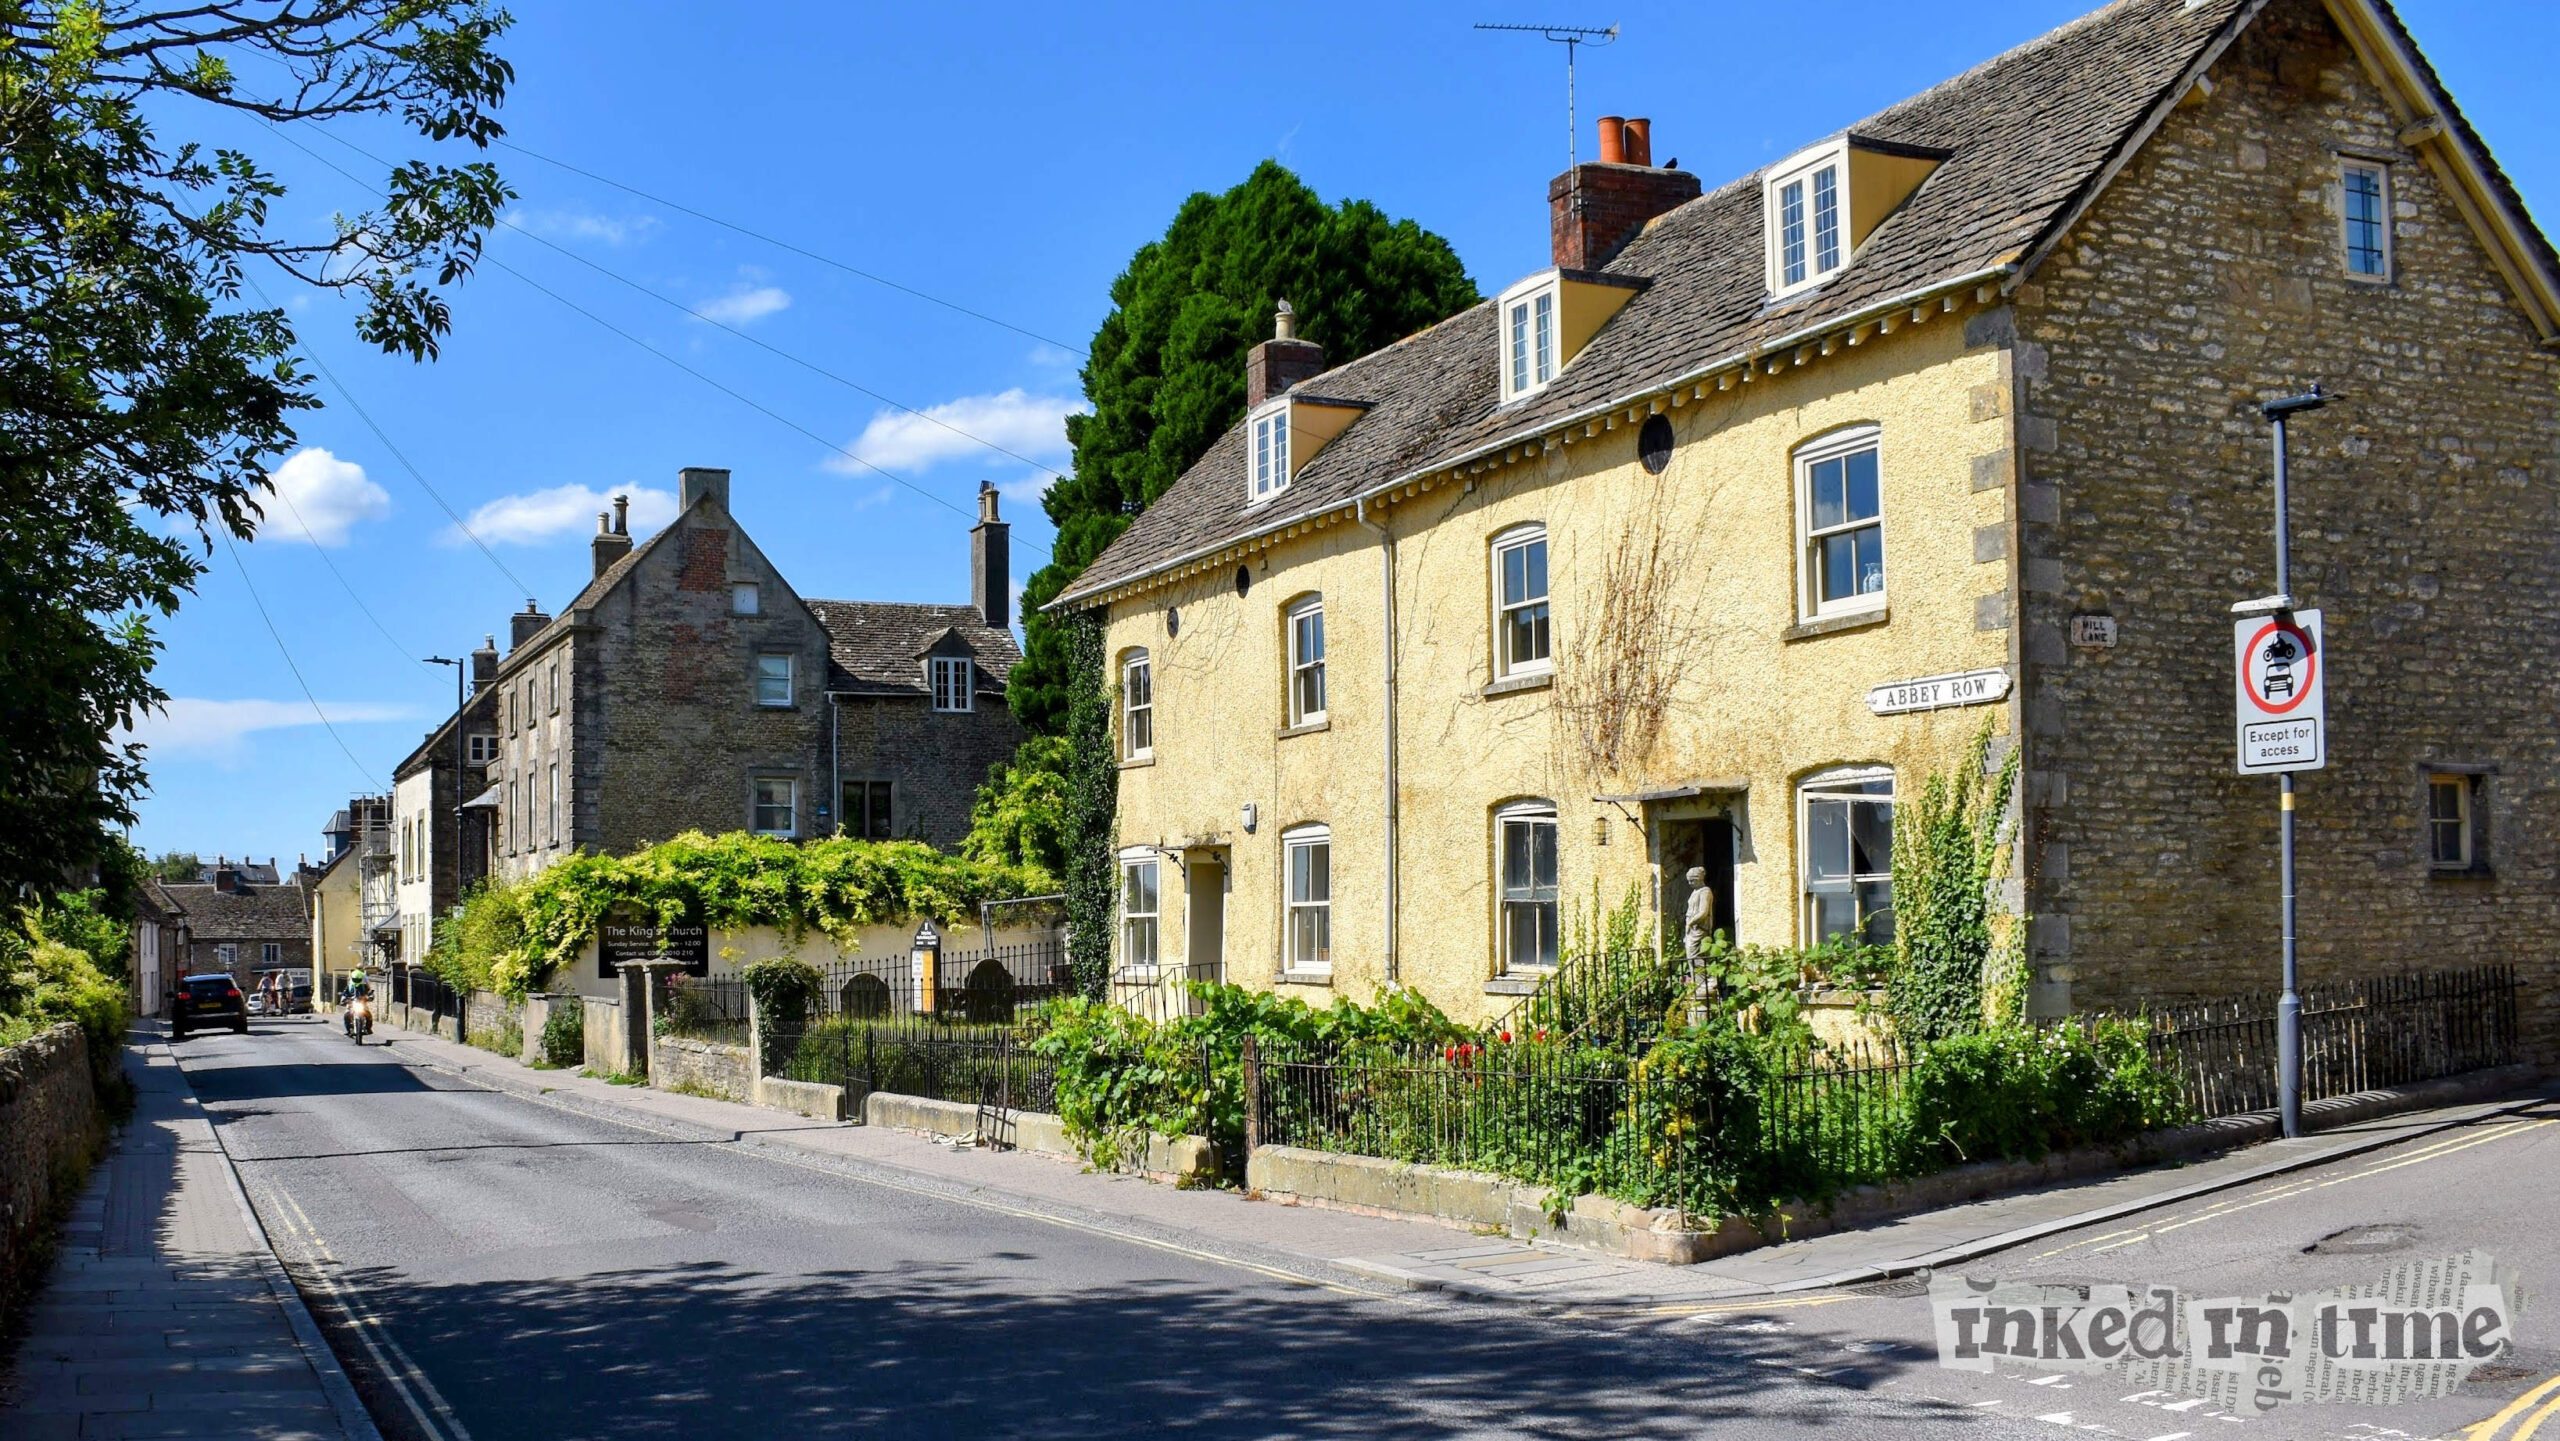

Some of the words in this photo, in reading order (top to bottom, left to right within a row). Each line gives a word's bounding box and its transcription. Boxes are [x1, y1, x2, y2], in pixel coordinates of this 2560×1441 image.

[2082, 620, 2105, 631] MILL
[2081, 632, 2107, 642] LANE
[1886, 684, 1941, 707] ABBEY
[1951, 678, 1987, 699] ROW
[2249, 728, 2290, 743] Except
[2293, 727, 2311, 740] for
[2260, 744, 2300, 758] access
[605, 925, 626, 936] The
[629, 925, 661, 939] King's
[669, 925, 703, 936] hurch
[608, 940, 628, 948] Sunday
